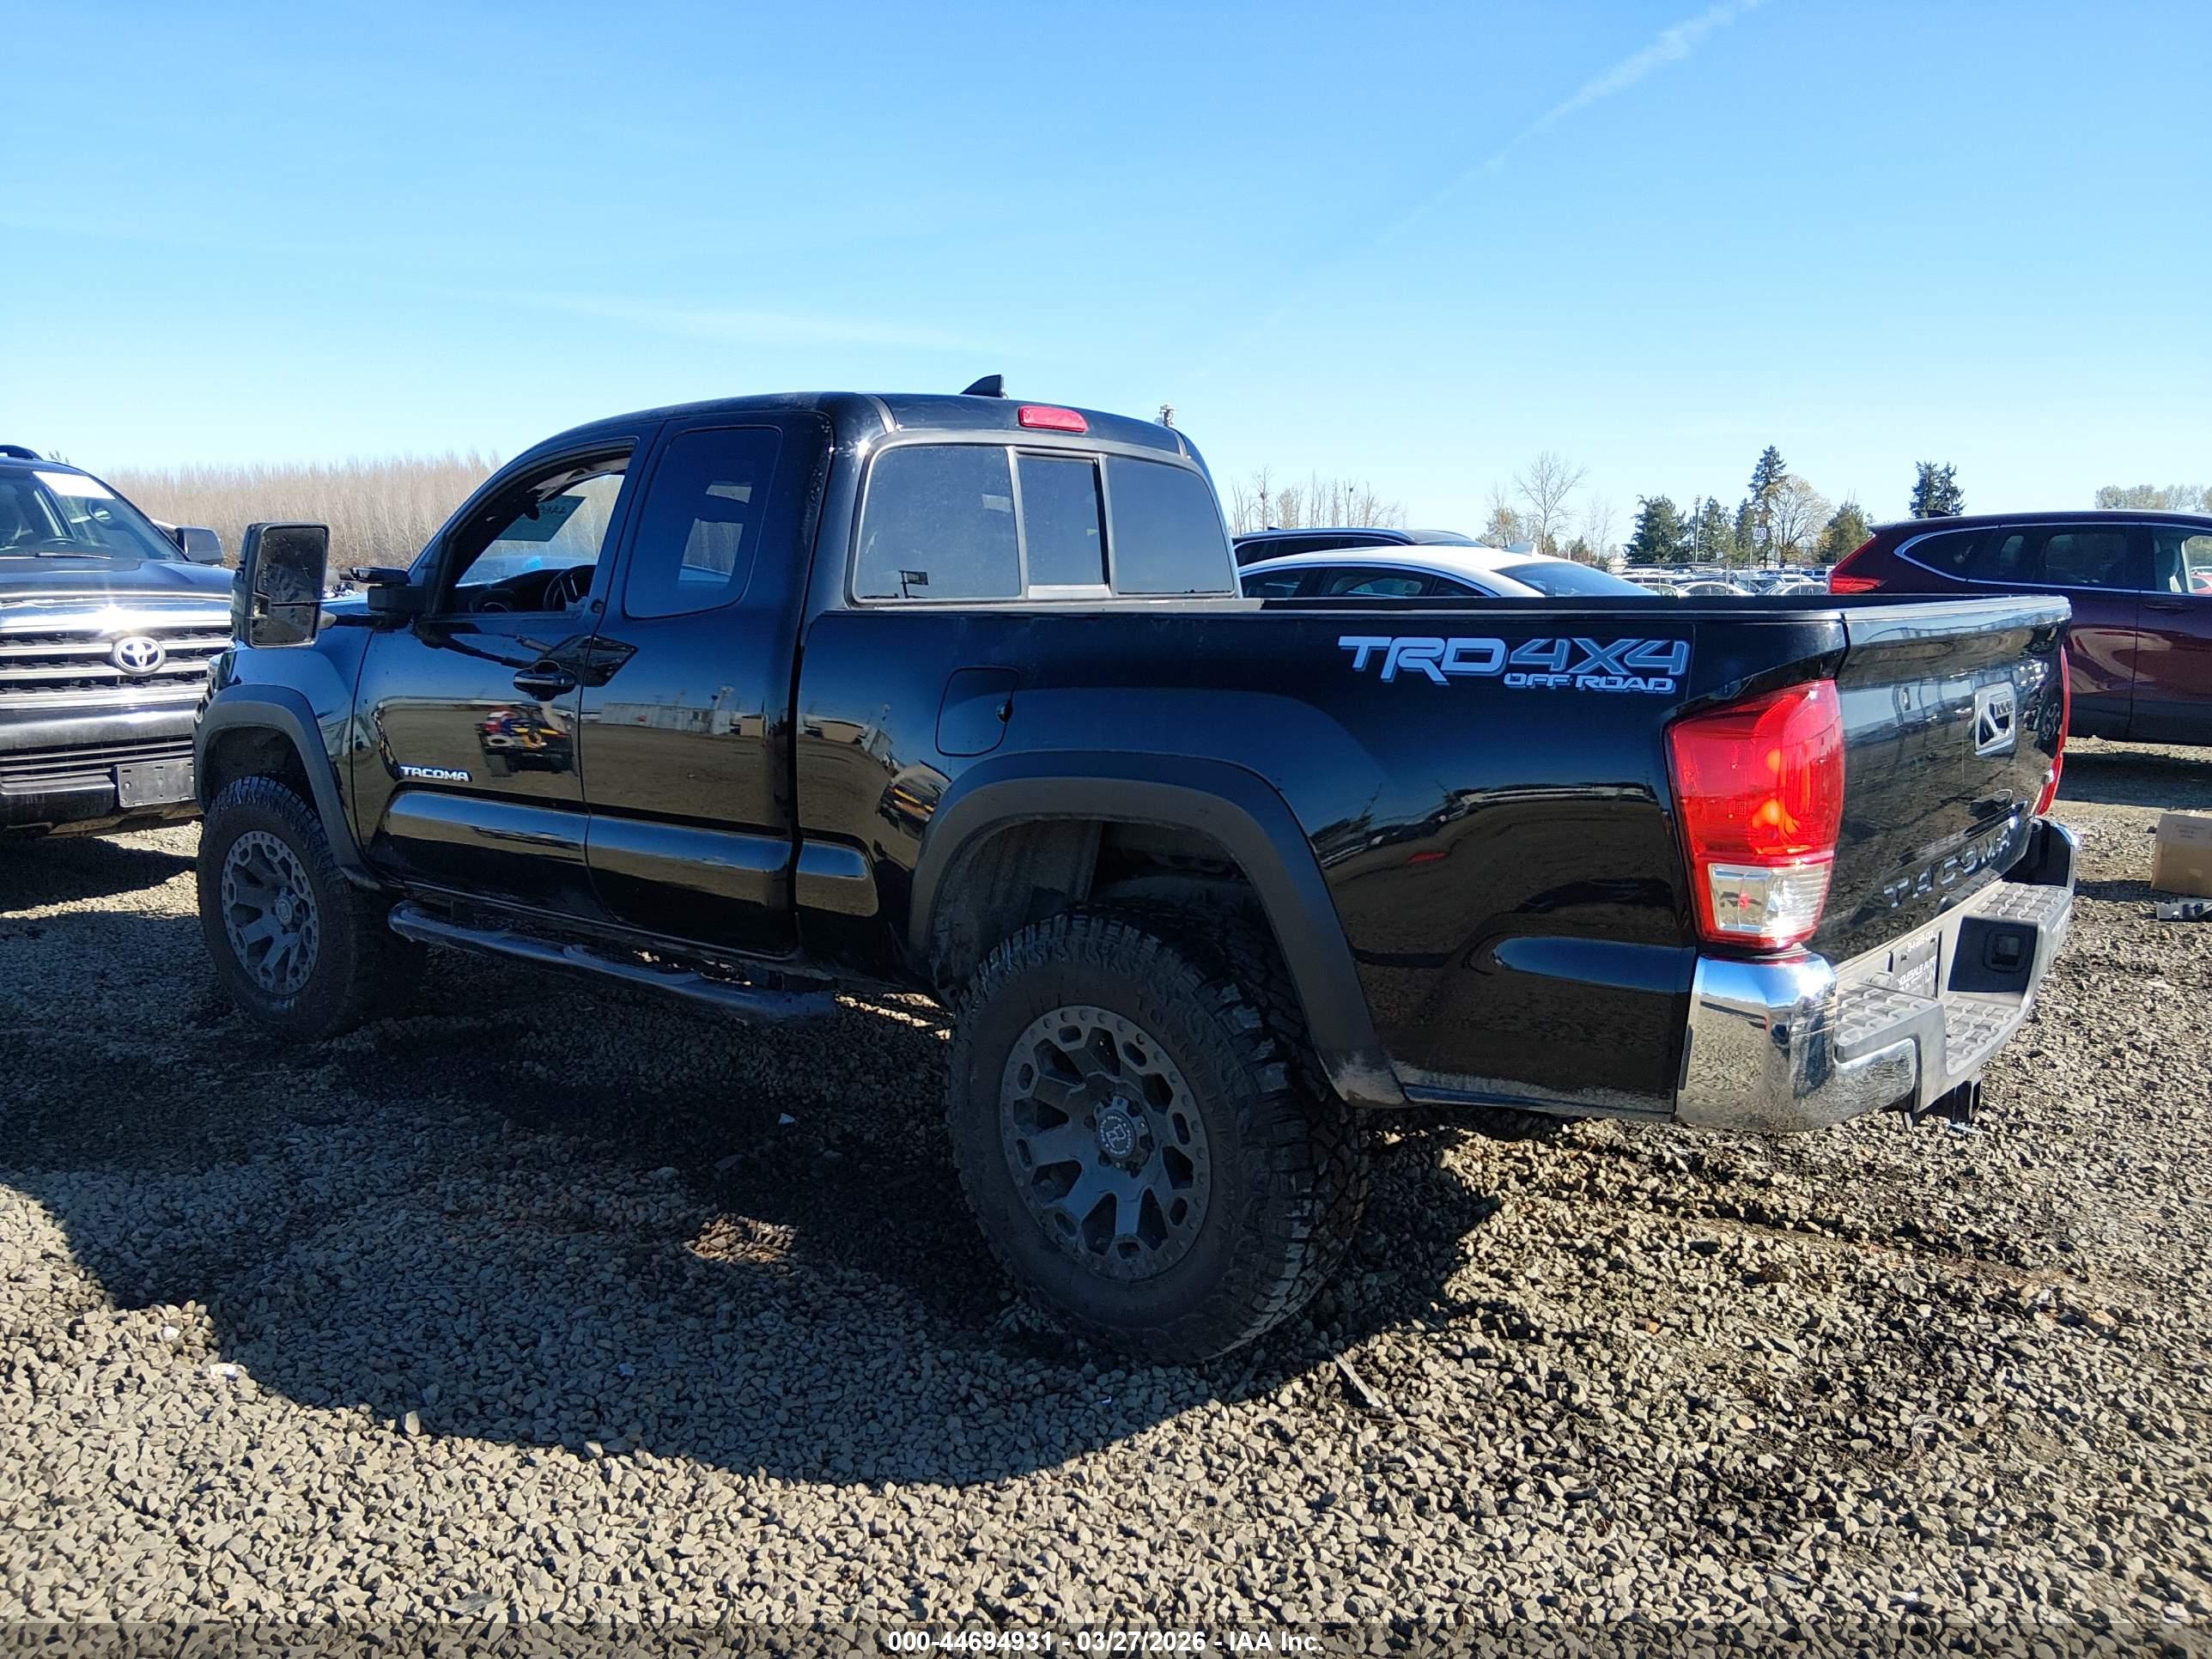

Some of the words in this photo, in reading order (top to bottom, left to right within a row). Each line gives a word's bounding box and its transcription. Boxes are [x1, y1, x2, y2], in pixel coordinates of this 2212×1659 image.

[1338, 635, 1509, 686] TRD
[1509, 637, 1691, 676] 4X4
[1504, 672, 1572, 690] OFF
[1575, 674, 1677, 694] ROAD
[400, 766, 470, 782] TACOMA
[1883, 827, 2011, 908] TACOMA
